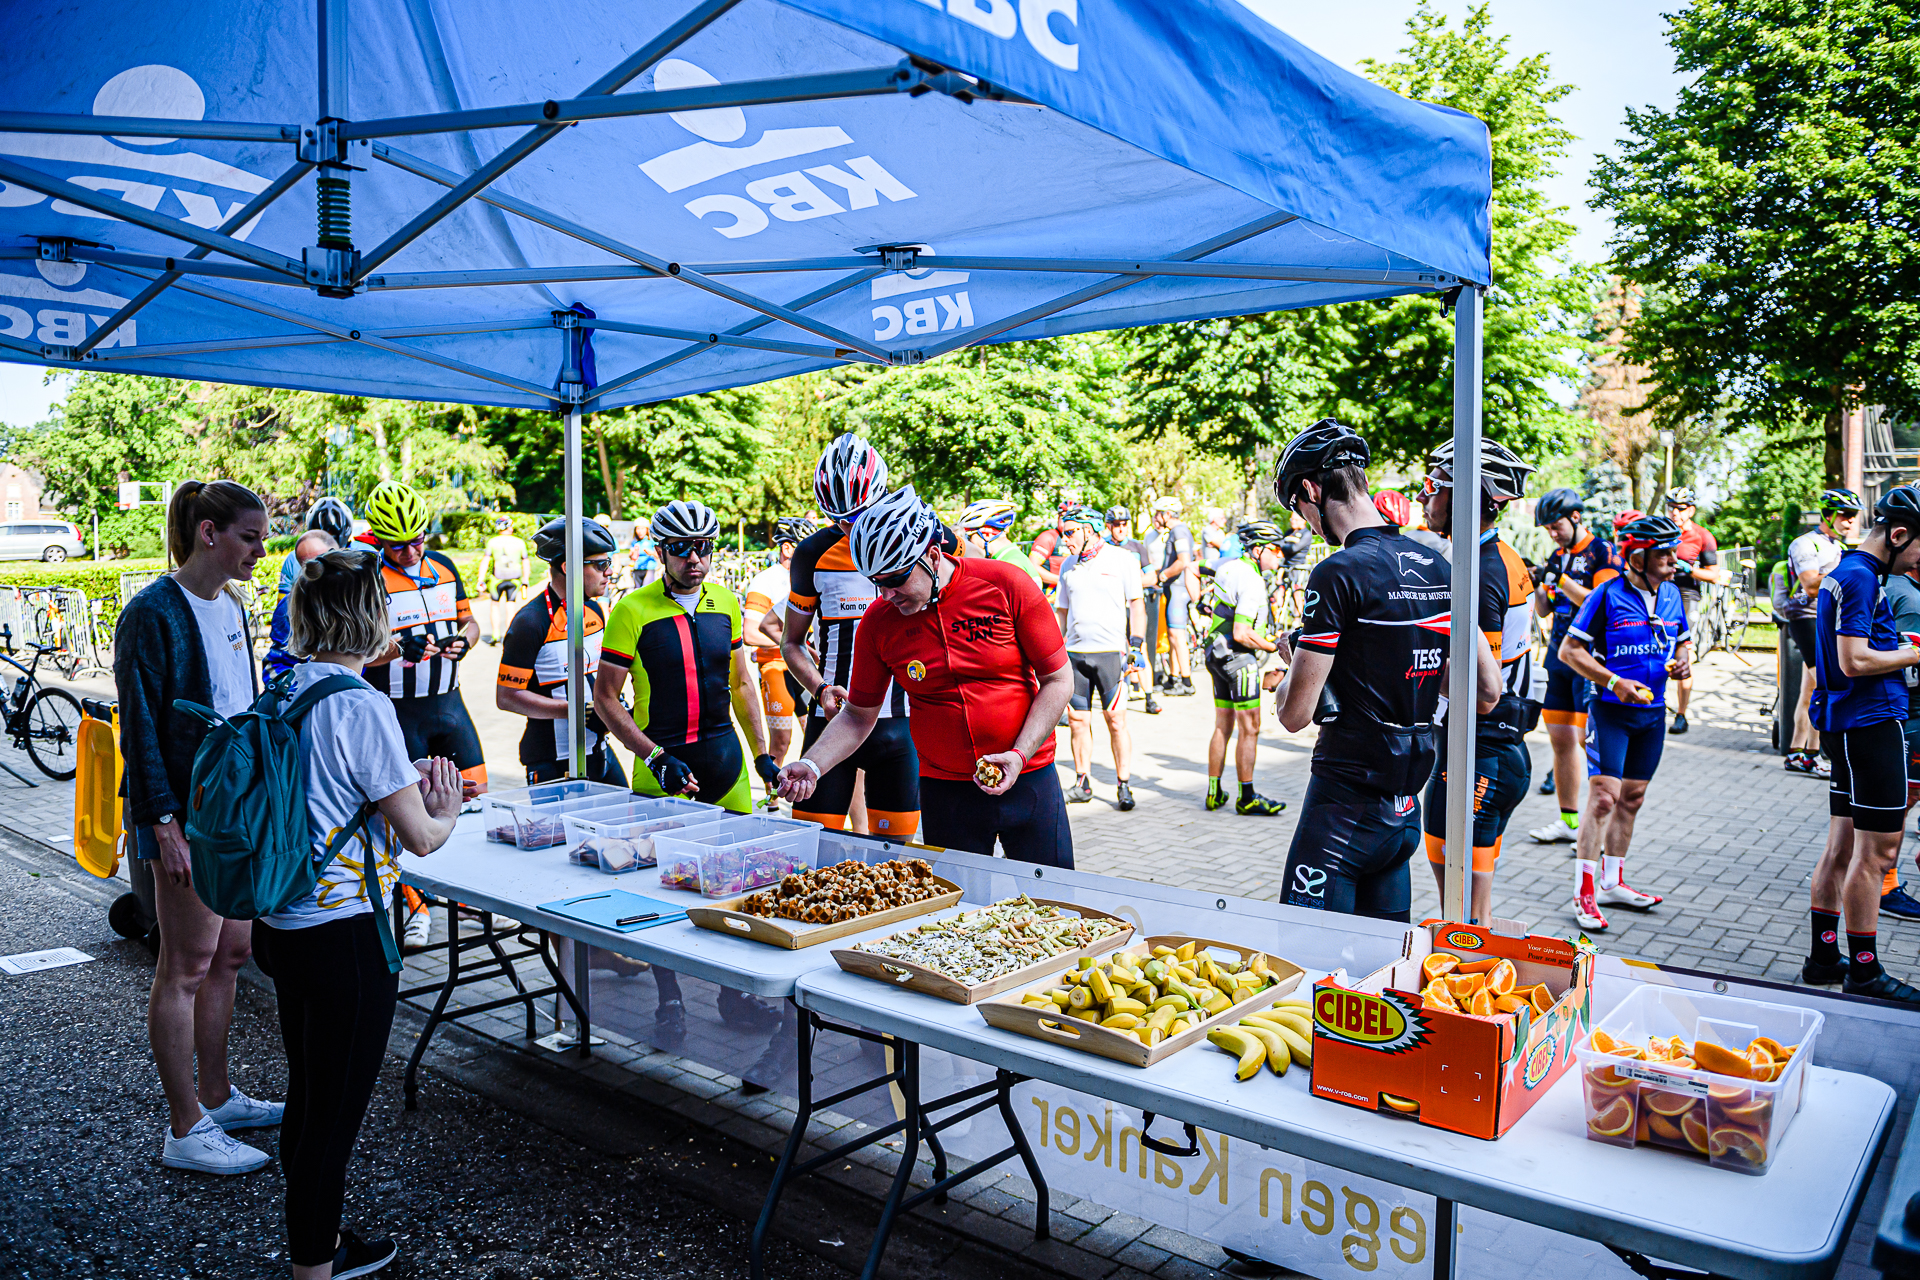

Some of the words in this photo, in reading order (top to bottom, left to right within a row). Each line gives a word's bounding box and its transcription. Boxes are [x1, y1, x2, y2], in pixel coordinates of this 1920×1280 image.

[917, 0, 1079, 72] BC
[858, 604, 867, 612] op
[951, 615, 1001, 633] STERKE
[966, 628, 994, 642] JAN
[1412, 648, 1442, 670] TESS
[1453, 934, 1476, 946] CIBEL
[1528, 952, 1543, 960] Pour
[1317, 993, 1394, 1036] CIBEL
[1531, 1046, 1549, 1078] CIBEL
[1316, 1084, 1369, 1103] www.v-ros.com
